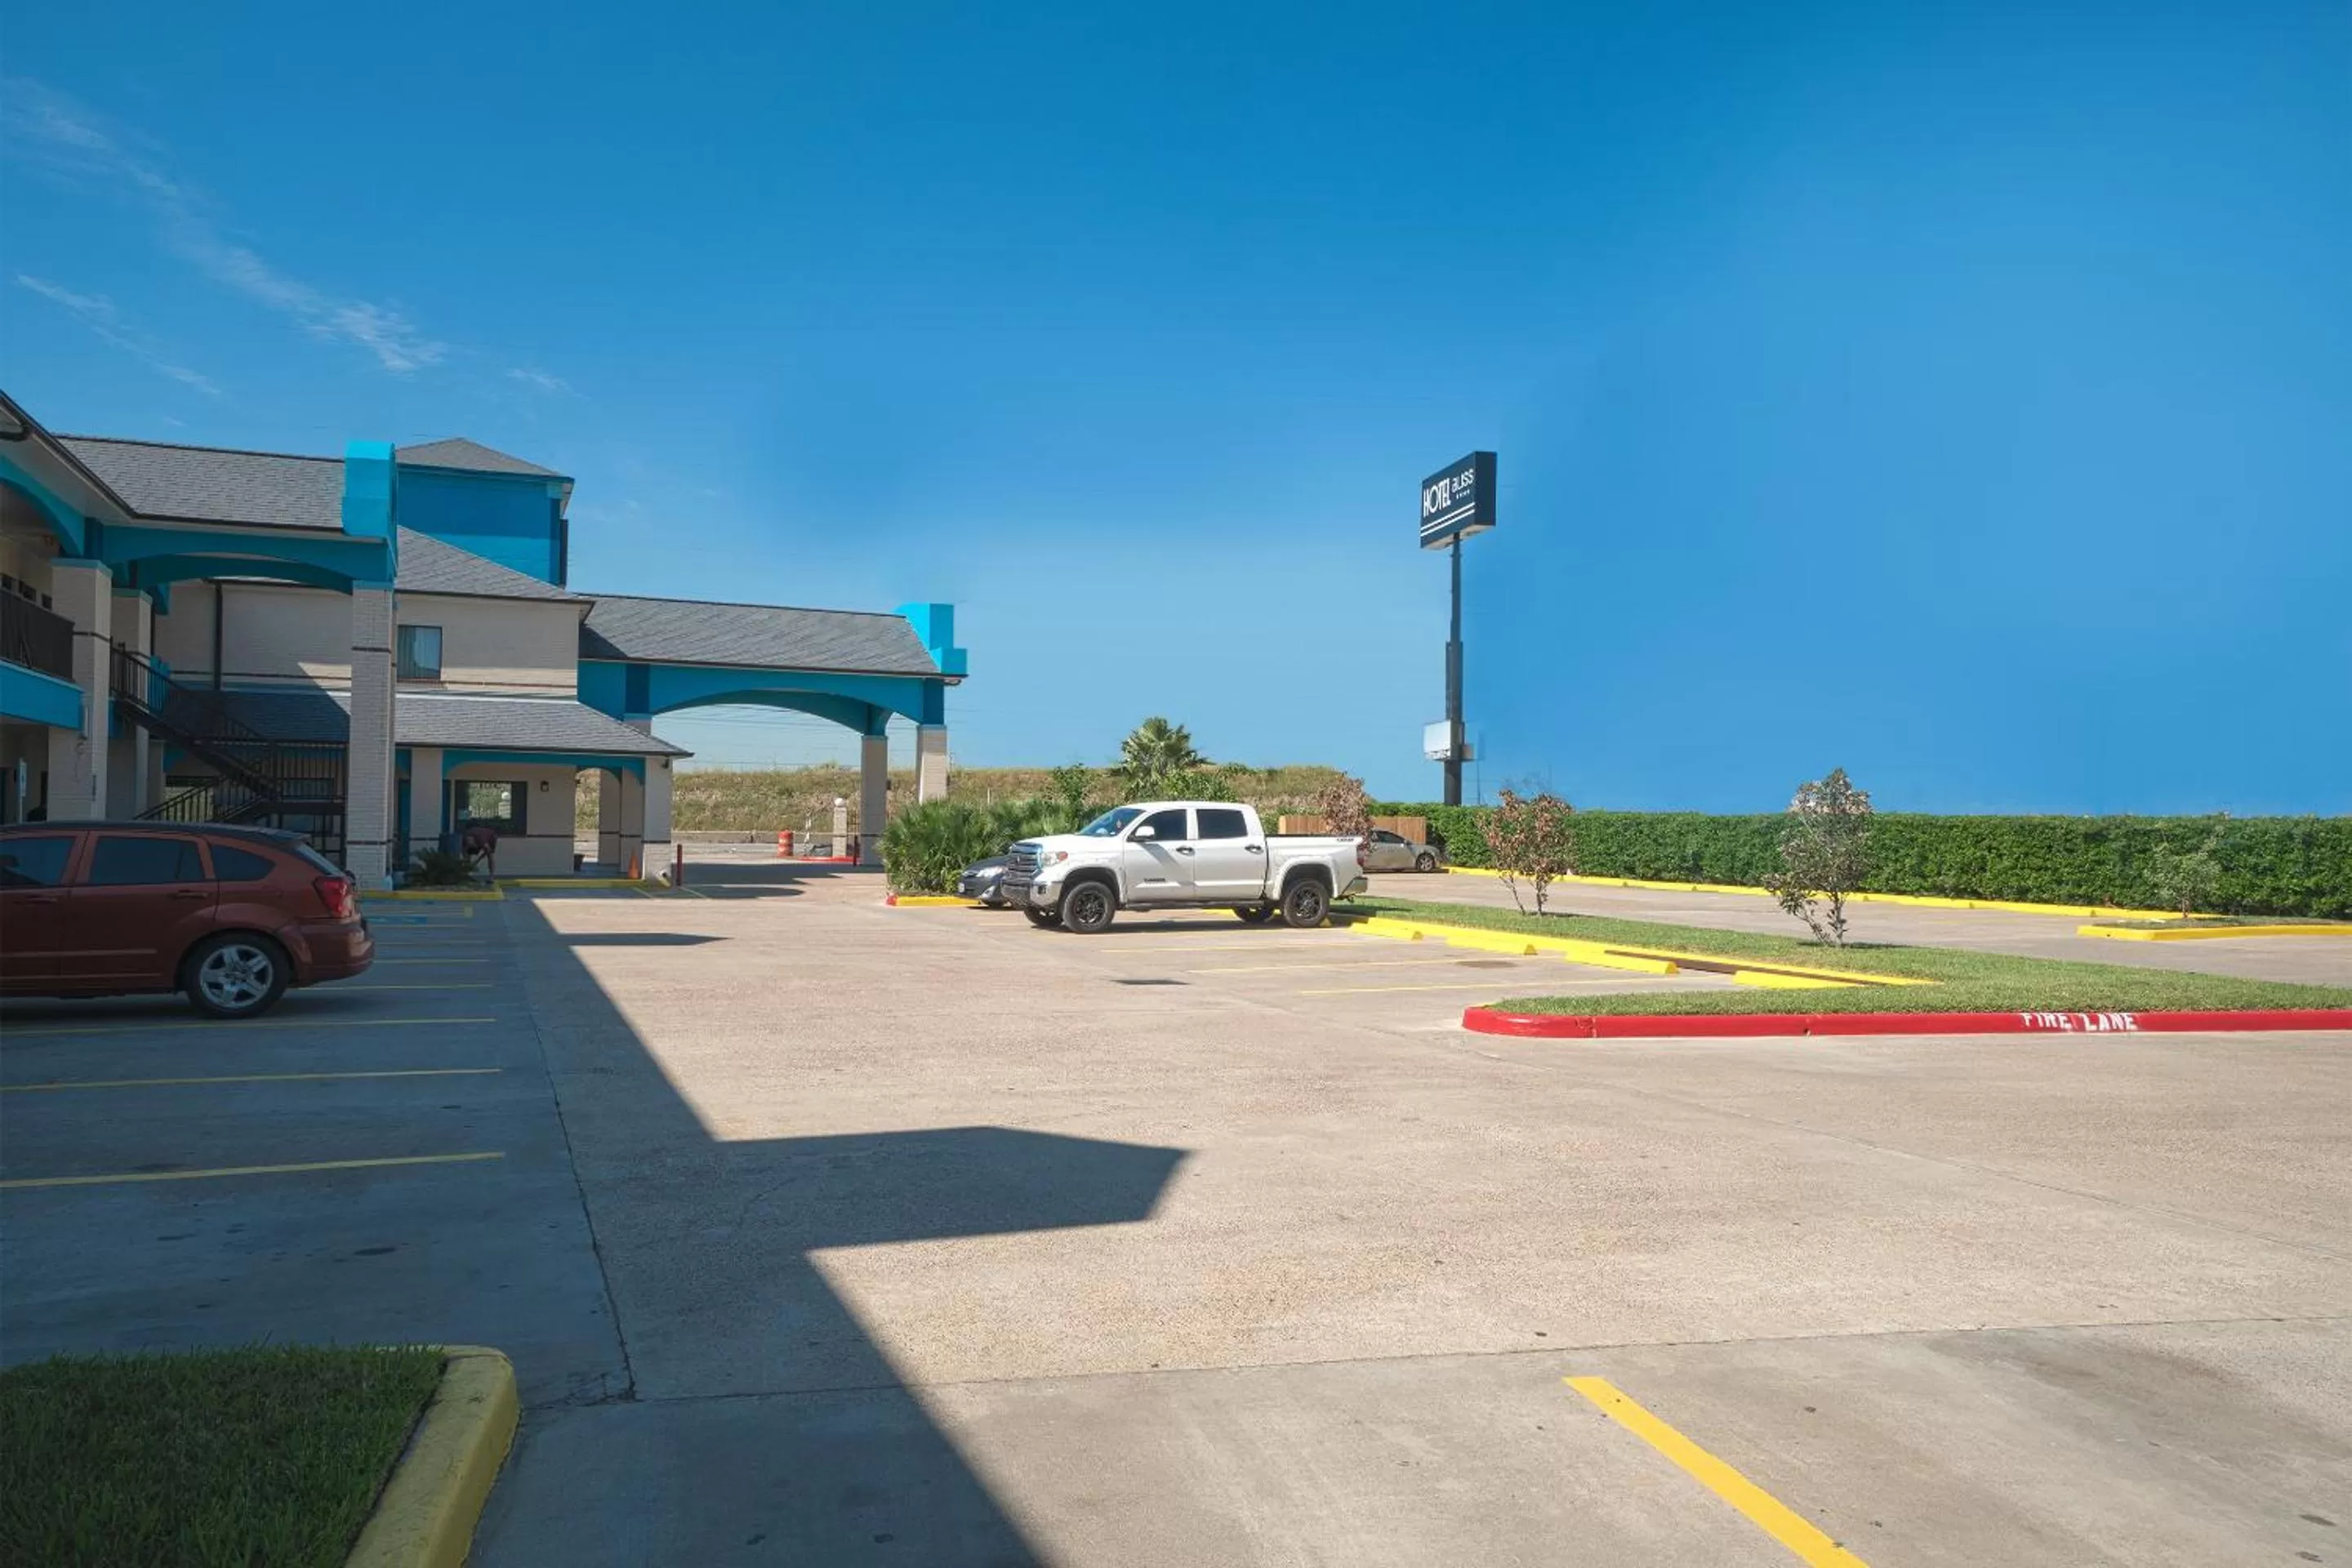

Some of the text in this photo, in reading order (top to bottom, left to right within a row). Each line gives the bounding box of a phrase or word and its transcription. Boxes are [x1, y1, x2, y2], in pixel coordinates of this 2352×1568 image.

[1423, 478, 1451, 518] HOTEL
[2020, 1012, 2138, 1031] FIRE LANE
